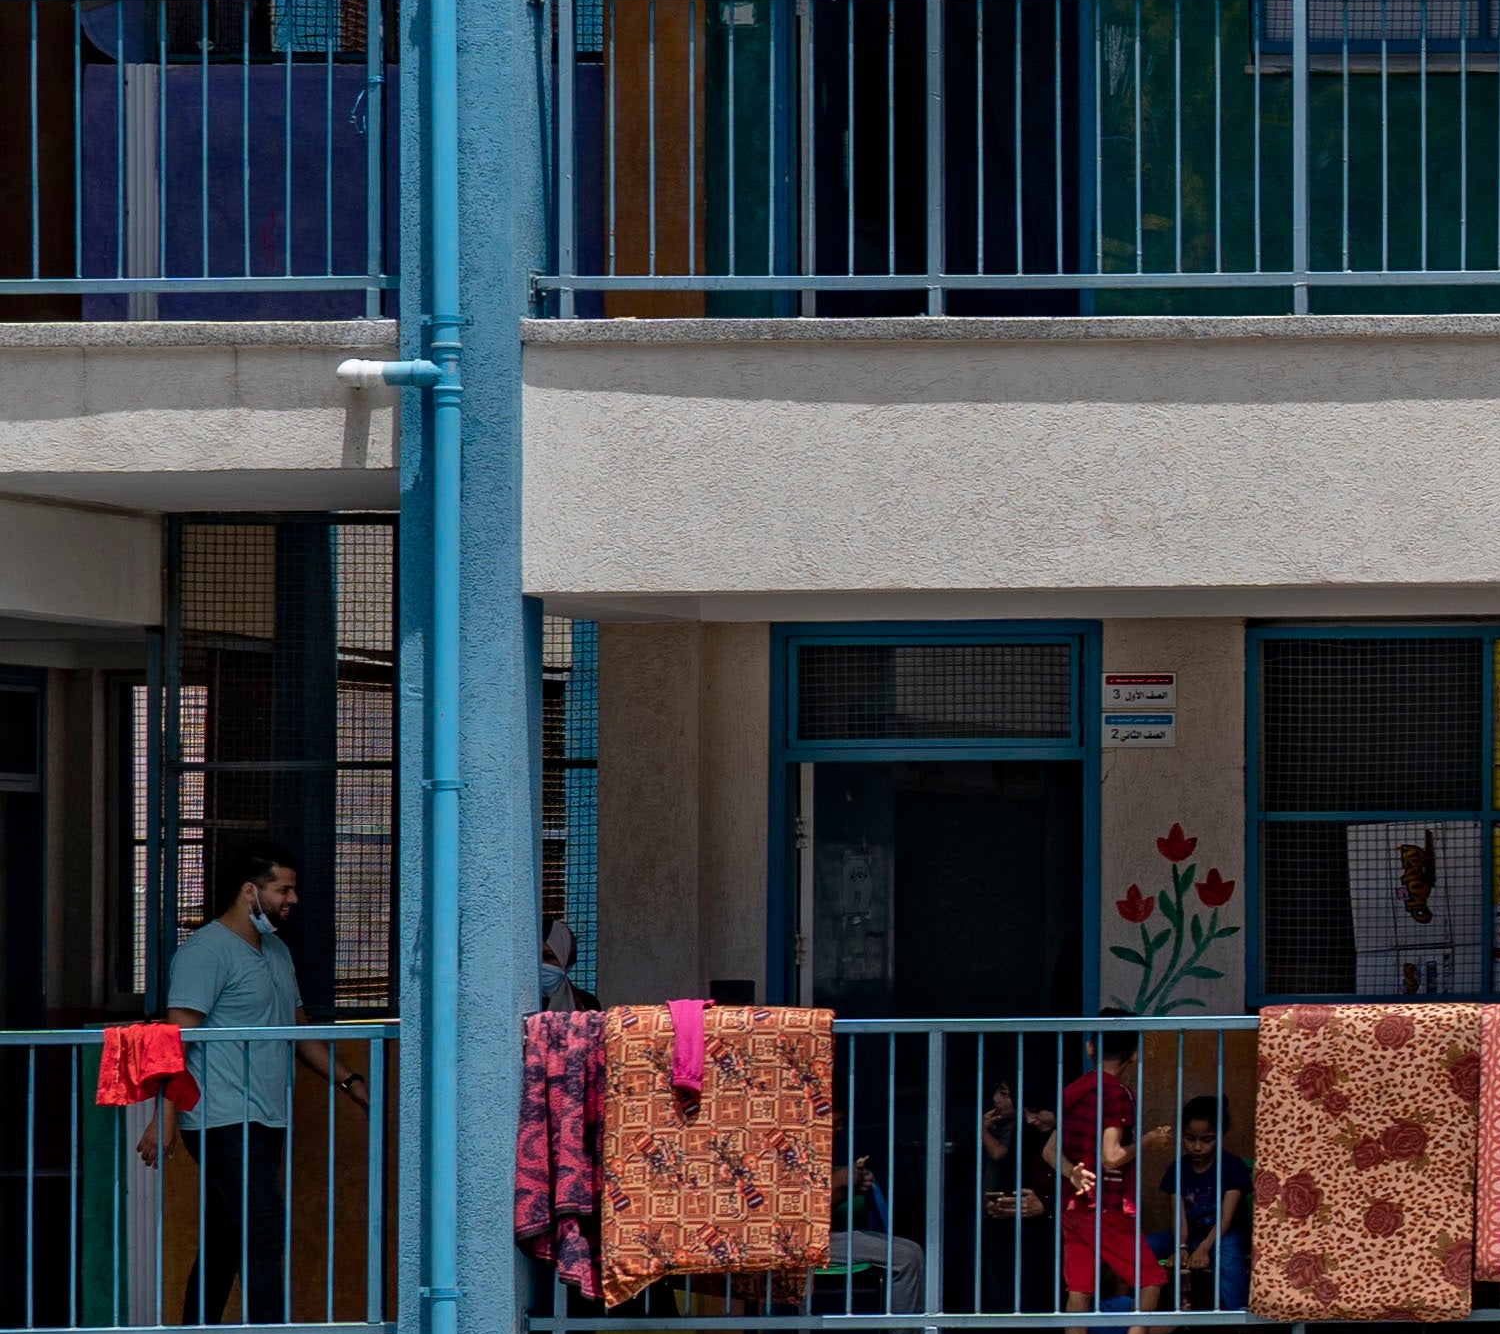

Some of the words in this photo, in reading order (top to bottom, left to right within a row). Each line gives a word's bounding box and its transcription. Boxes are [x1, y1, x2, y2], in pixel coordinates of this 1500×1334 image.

[1113, 690, 1120, 699] 3
[1146, 690, 1168, 701] الصف
[1111, 729, 1119, 739] 2
[1143, 729, 1166, 741] الصف
